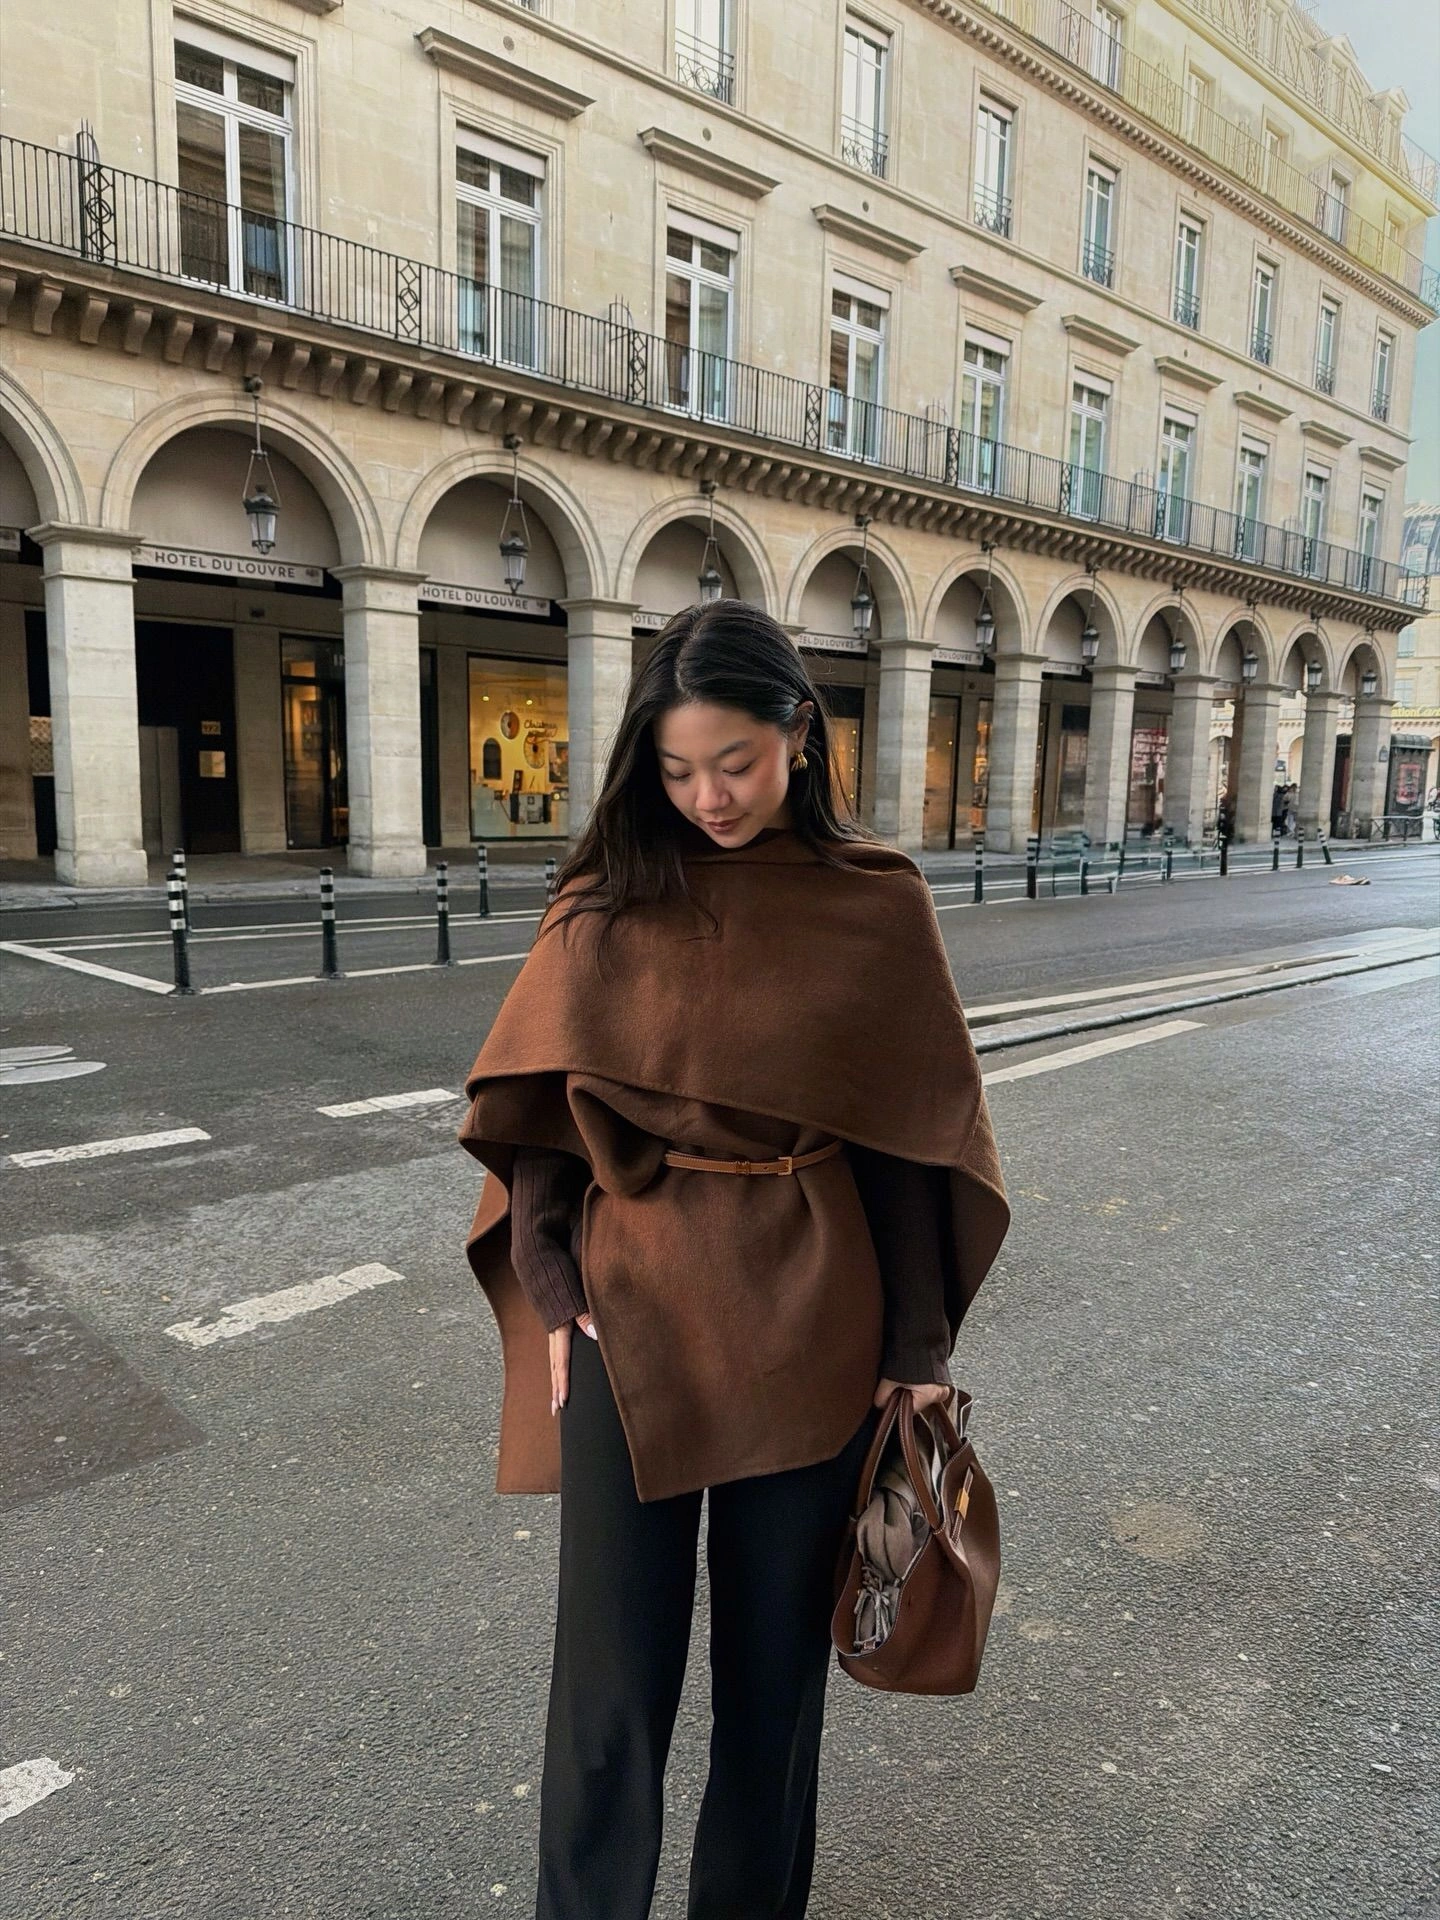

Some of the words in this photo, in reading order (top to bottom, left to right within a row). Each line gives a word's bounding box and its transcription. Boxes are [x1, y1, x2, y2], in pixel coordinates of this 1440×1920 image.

[154, 551, 207, 568] HOTEL
[212, 558, 233, 571] DU
[237, 561, 296, 578] LOUVRE
[422, 586, 462, 600] HOTEL
[465, 592, 482, 603] DU
[484, 595, 528, 610] LOUVRE
[632, 614, 658, 625] OTEL
